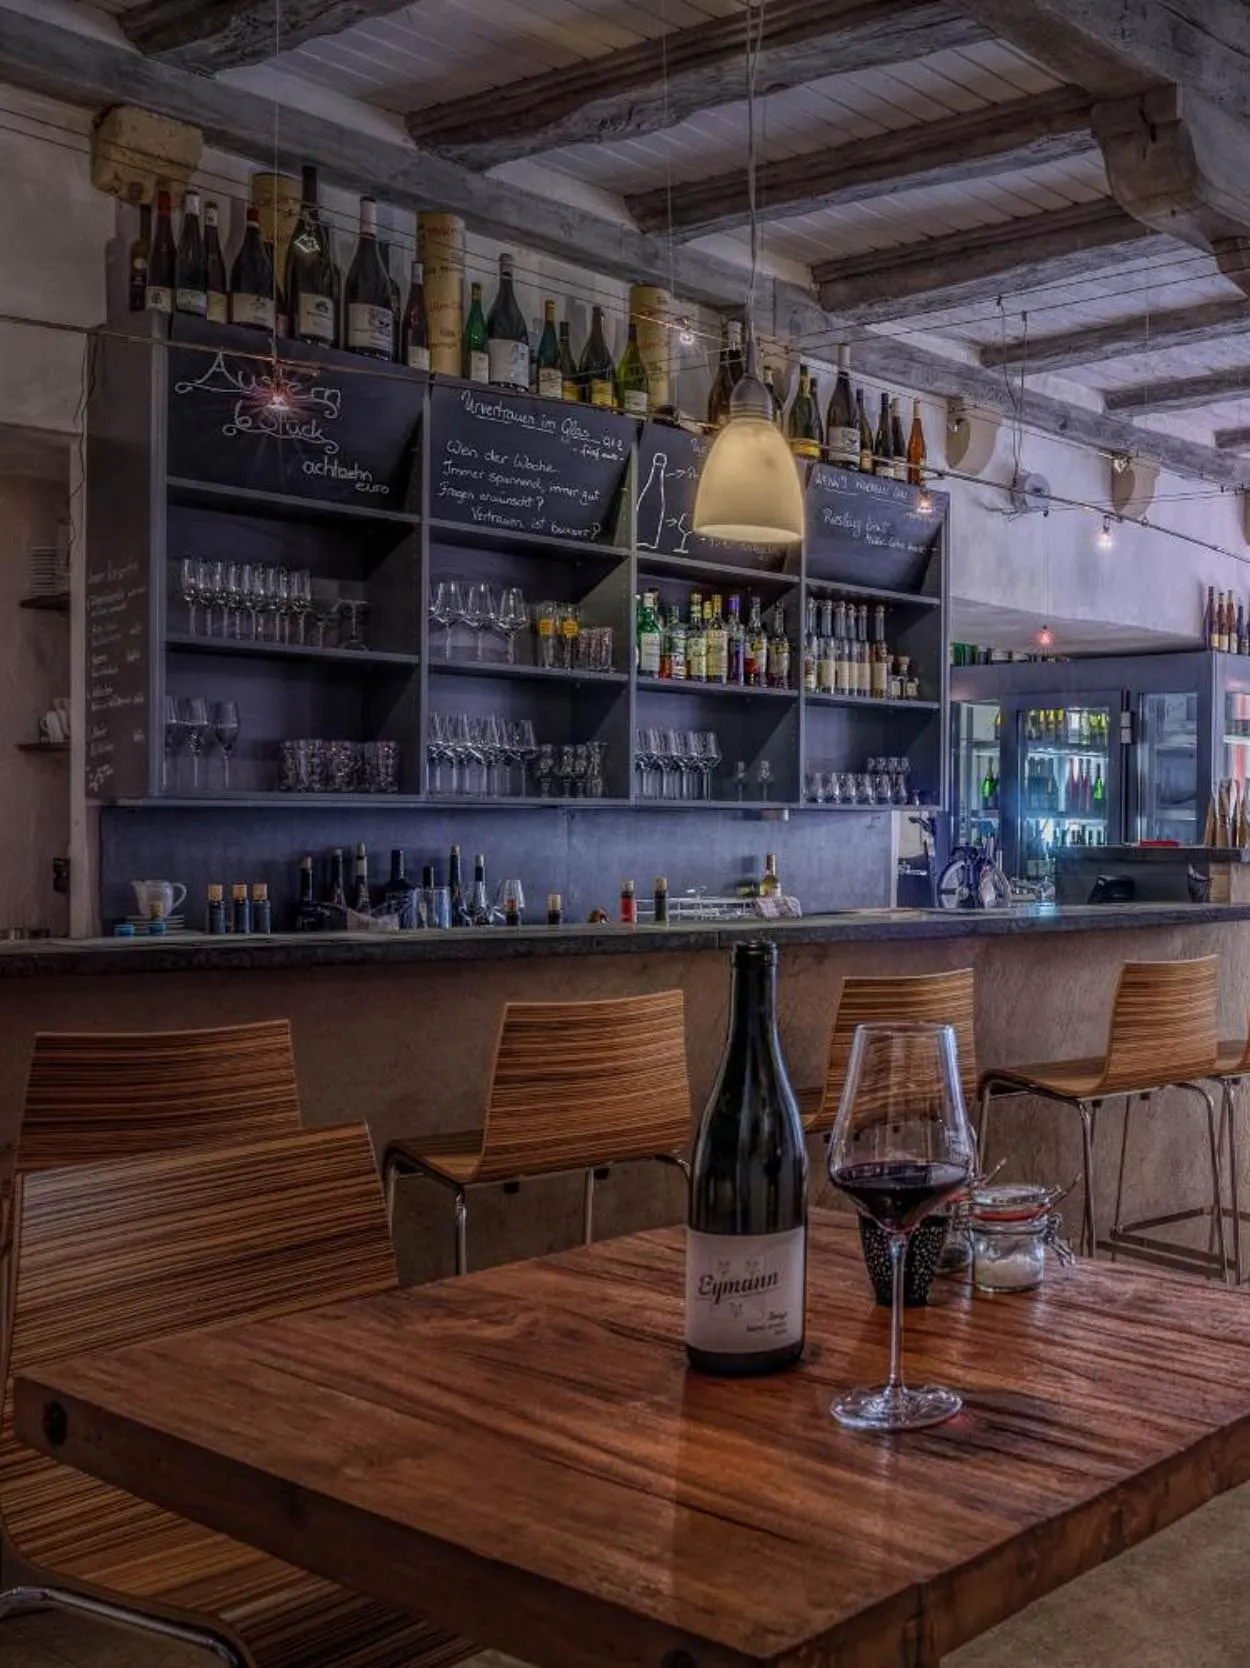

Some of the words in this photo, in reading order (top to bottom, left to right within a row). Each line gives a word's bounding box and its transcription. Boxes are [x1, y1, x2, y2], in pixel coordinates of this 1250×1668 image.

[235, 400, 253, 430] 6
[541, 414, 556, 429] im
[561, 417, 590, 445] Glas
[484, 449, 510, 465] der
[436, 480, 475, 504] Fragen
[440, 461, 485, 480] Immer
[549, 485, 579, 498] immer
[471, 505, 525, 529] Vertrauen
[531, 515, 547, 530] ist
[698, 1271, 779, 1306] Eymann
